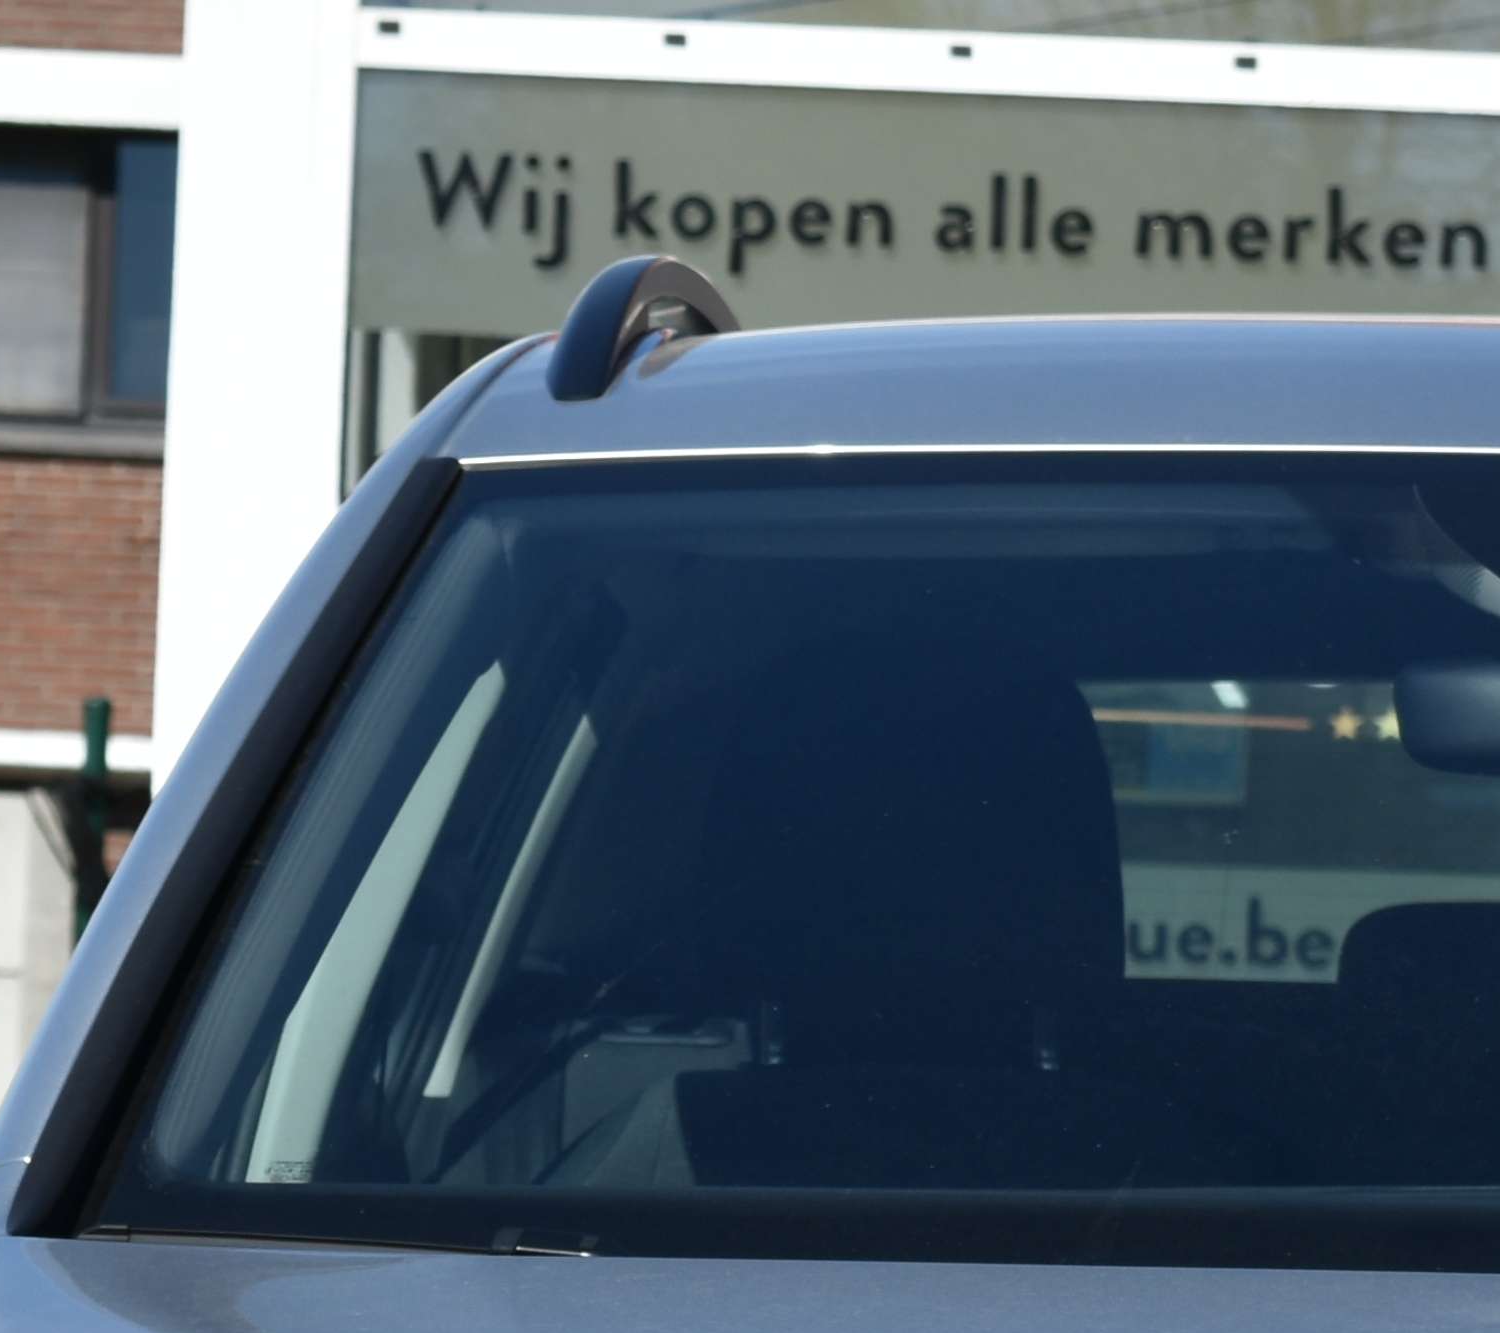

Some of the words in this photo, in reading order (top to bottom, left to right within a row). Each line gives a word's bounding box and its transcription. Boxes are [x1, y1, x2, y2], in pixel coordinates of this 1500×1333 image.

[418, 148, 572, 270] Wij
[613, 158, 894, 274] kopen
[934, 172, 1094, 256] alle
[1133, 186, 1489, 270] merken
